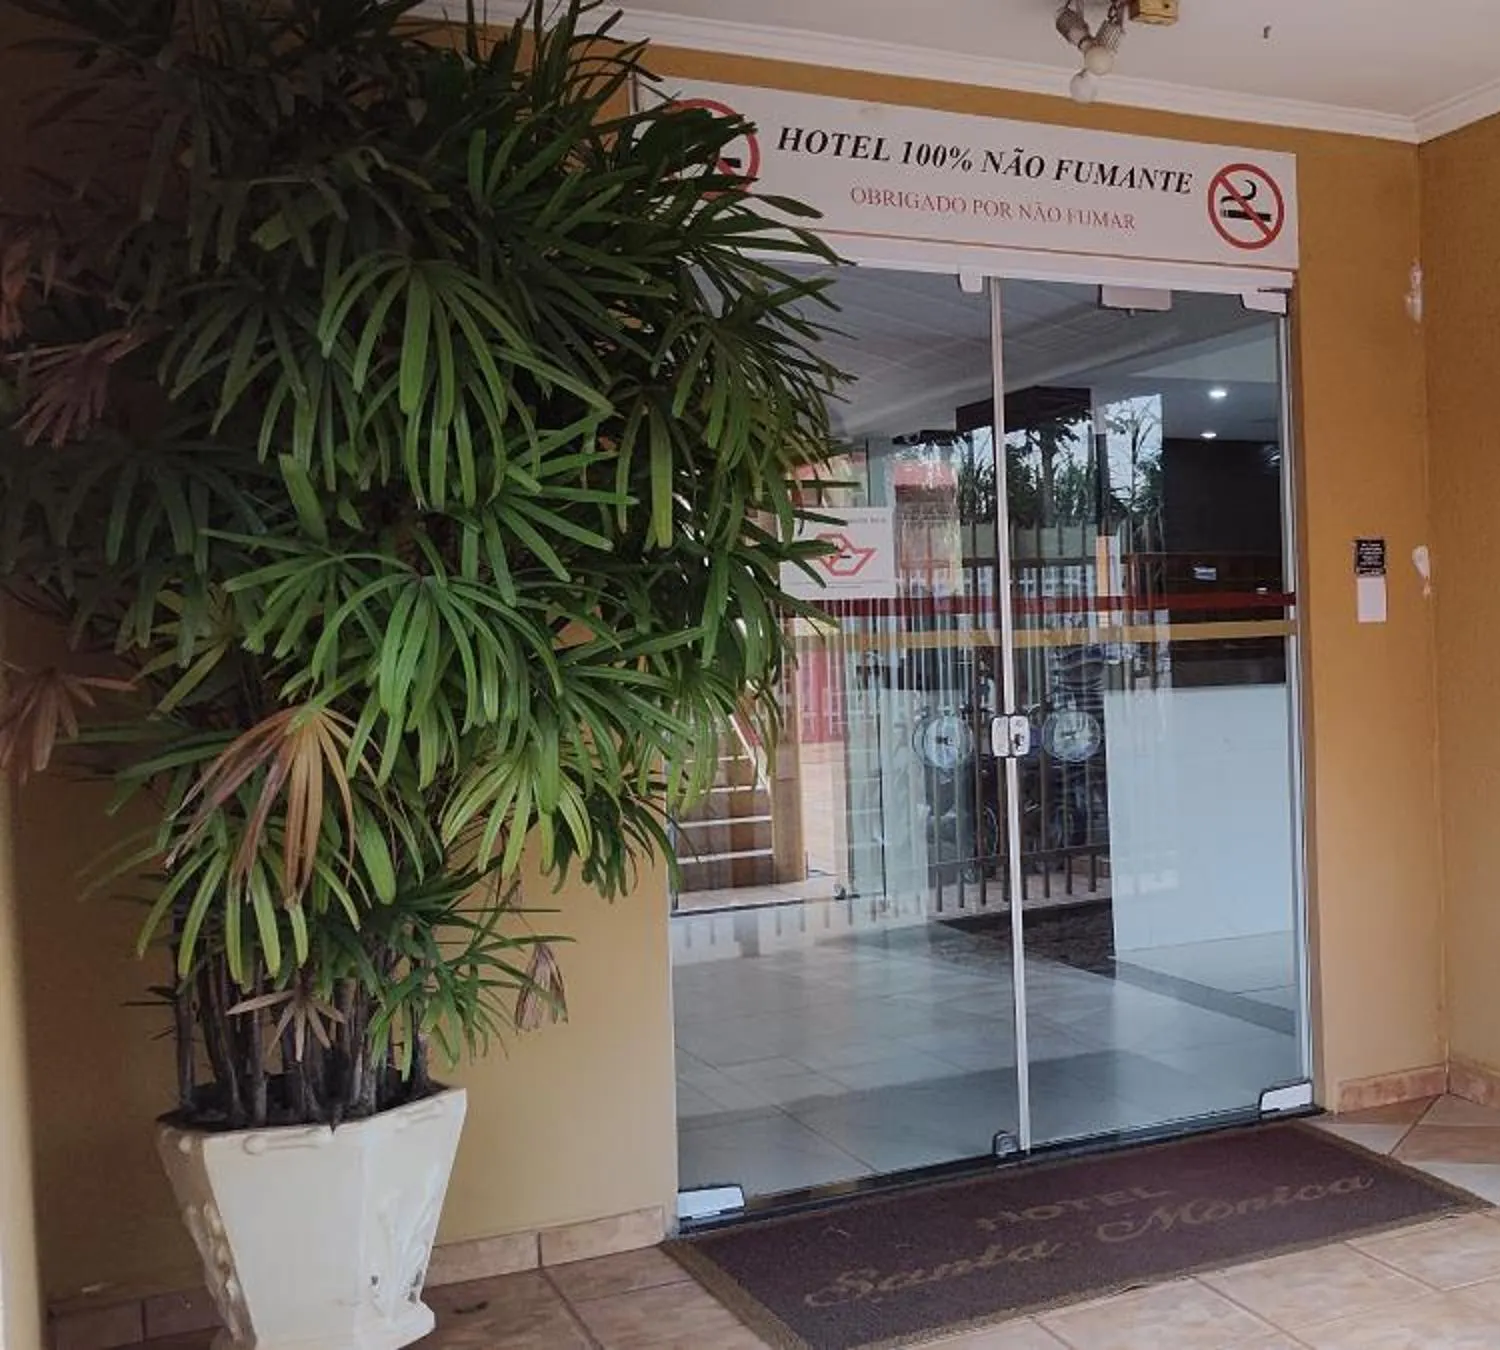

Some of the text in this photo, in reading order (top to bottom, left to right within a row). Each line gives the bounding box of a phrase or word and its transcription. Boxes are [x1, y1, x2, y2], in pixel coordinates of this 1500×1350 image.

[778, 126, 1193, 194] HOTEL 100% NÃO FUMANTE
[850, 186, 1135, 229] OBRIGADO POR NÃO FUMAR
[974, 1187, 1172, 1230] HOTEL
[803, 1240, 1064, 1307] Santa
